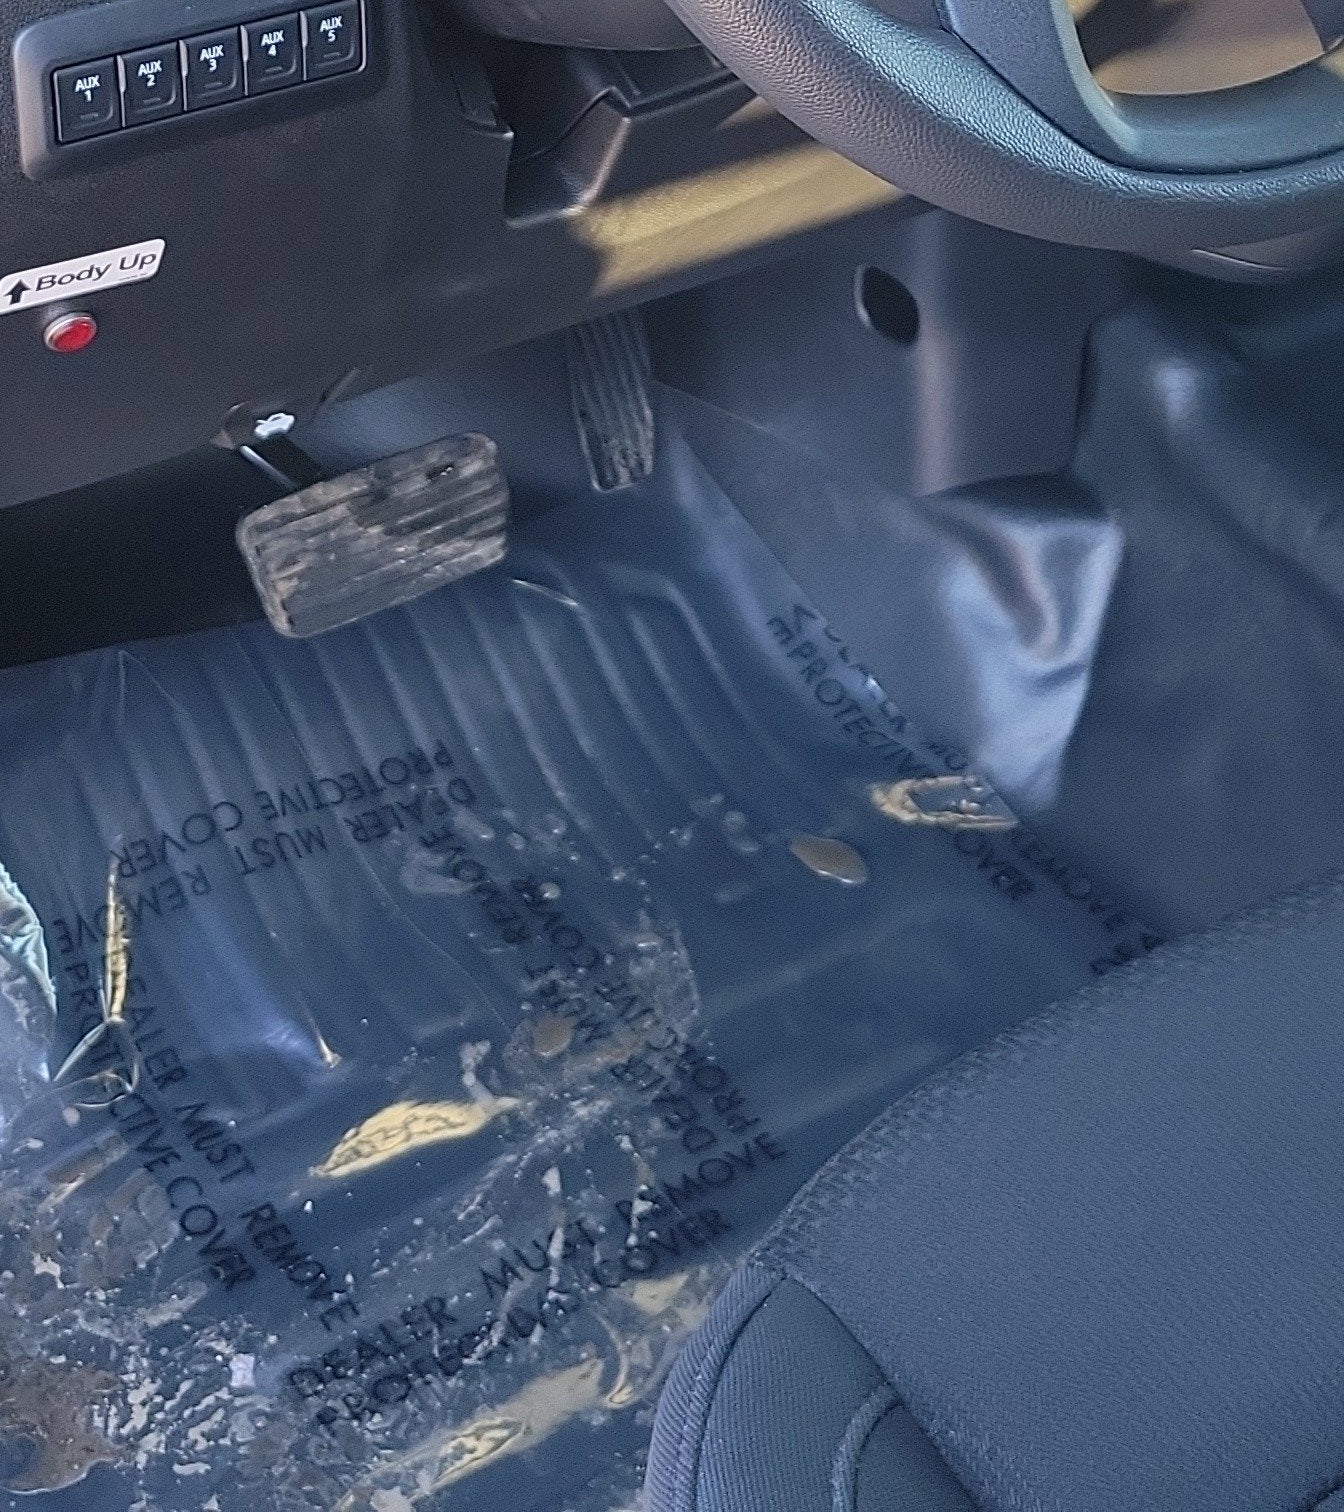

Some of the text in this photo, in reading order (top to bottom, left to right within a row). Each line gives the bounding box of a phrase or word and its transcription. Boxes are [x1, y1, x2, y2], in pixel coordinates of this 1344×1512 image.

[319, 15, 343, 32] AUX
[260, 29, 285, 47] AUX
[327, 30, 336, 43] 5
[199, 44, 224, 61] AUX
[267, 45, 277, 57] 4
[137, 60, 162, 77] AUX
[209, 59, 218, 72] 3
[75, 75, 101, 93] AUX
[146, 74, 156, 87] 2
[84, 90, 92, 103] 1
[35, 253, 157, 292] Body Up
[111, 739, 454, 879] PROTECTIVE COVER
[346, 777, 477, 844] DEALER
[234, 824, 329, 876] MUST
[171, 1101, 256, 1184] MUST
[237, 1202, 360, 1332] REMOVE
[165, 1175, 255, 1291] COVER
